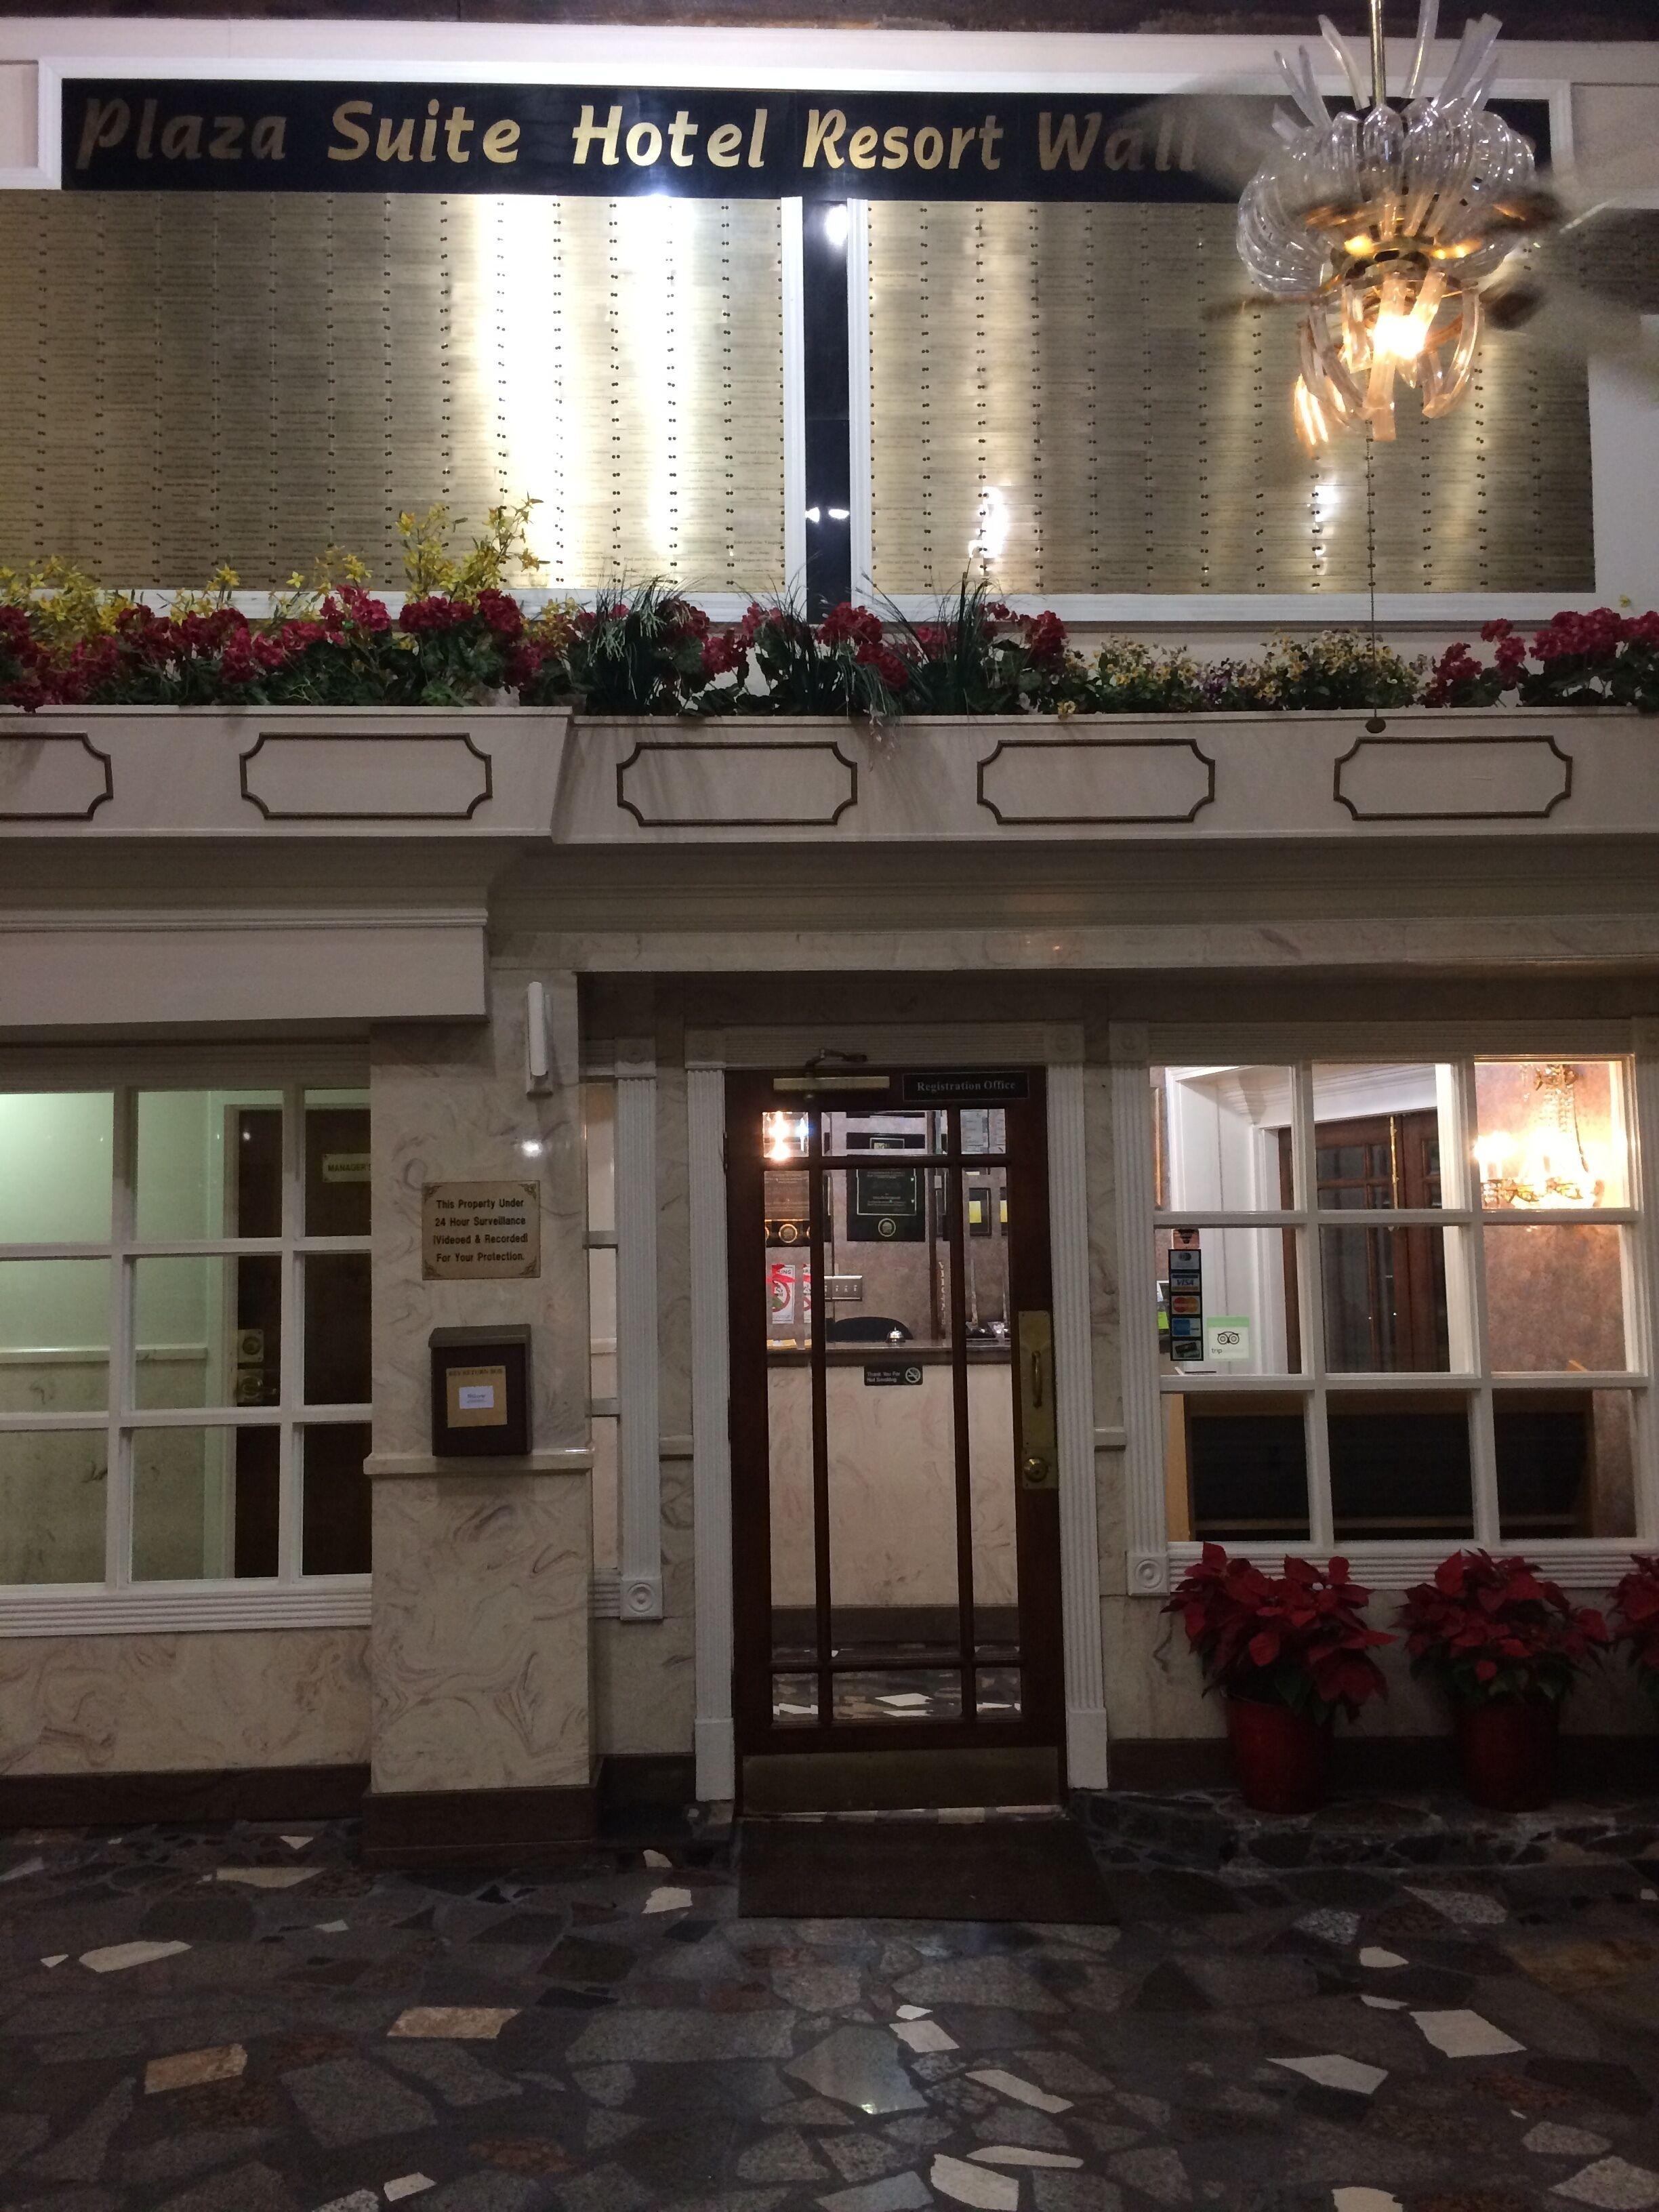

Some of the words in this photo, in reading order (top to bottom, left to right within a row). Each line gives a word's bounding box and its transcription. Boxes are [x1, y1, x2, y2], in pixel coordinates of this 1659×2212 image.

[75, 97, 287, 170] Plaza
[327, 98, 521, 163] Suite
[572, 105, 768, 168] Hotel
[802, 108, 1004, 170] Resort
[917, 1081, 981, 1093] Registration
[984, 1080, 1015, 1090] Office
[436, 1200, 455, 1209] This
[458, 1199, 496, 1210] Property
[499, 1197, 524, 1208] Under
[435, 1218, 446, 1227] 24
[450, 1217, 470, 1227] Hour
[473, 1216, 526, 1226] Surveillance
[474, 1234, 481, 1244] &
[436, 1253, 451, 1263] For
[455, 1252, 474, 1263] Your
[476, 1251, 525, 1262] Protection.
